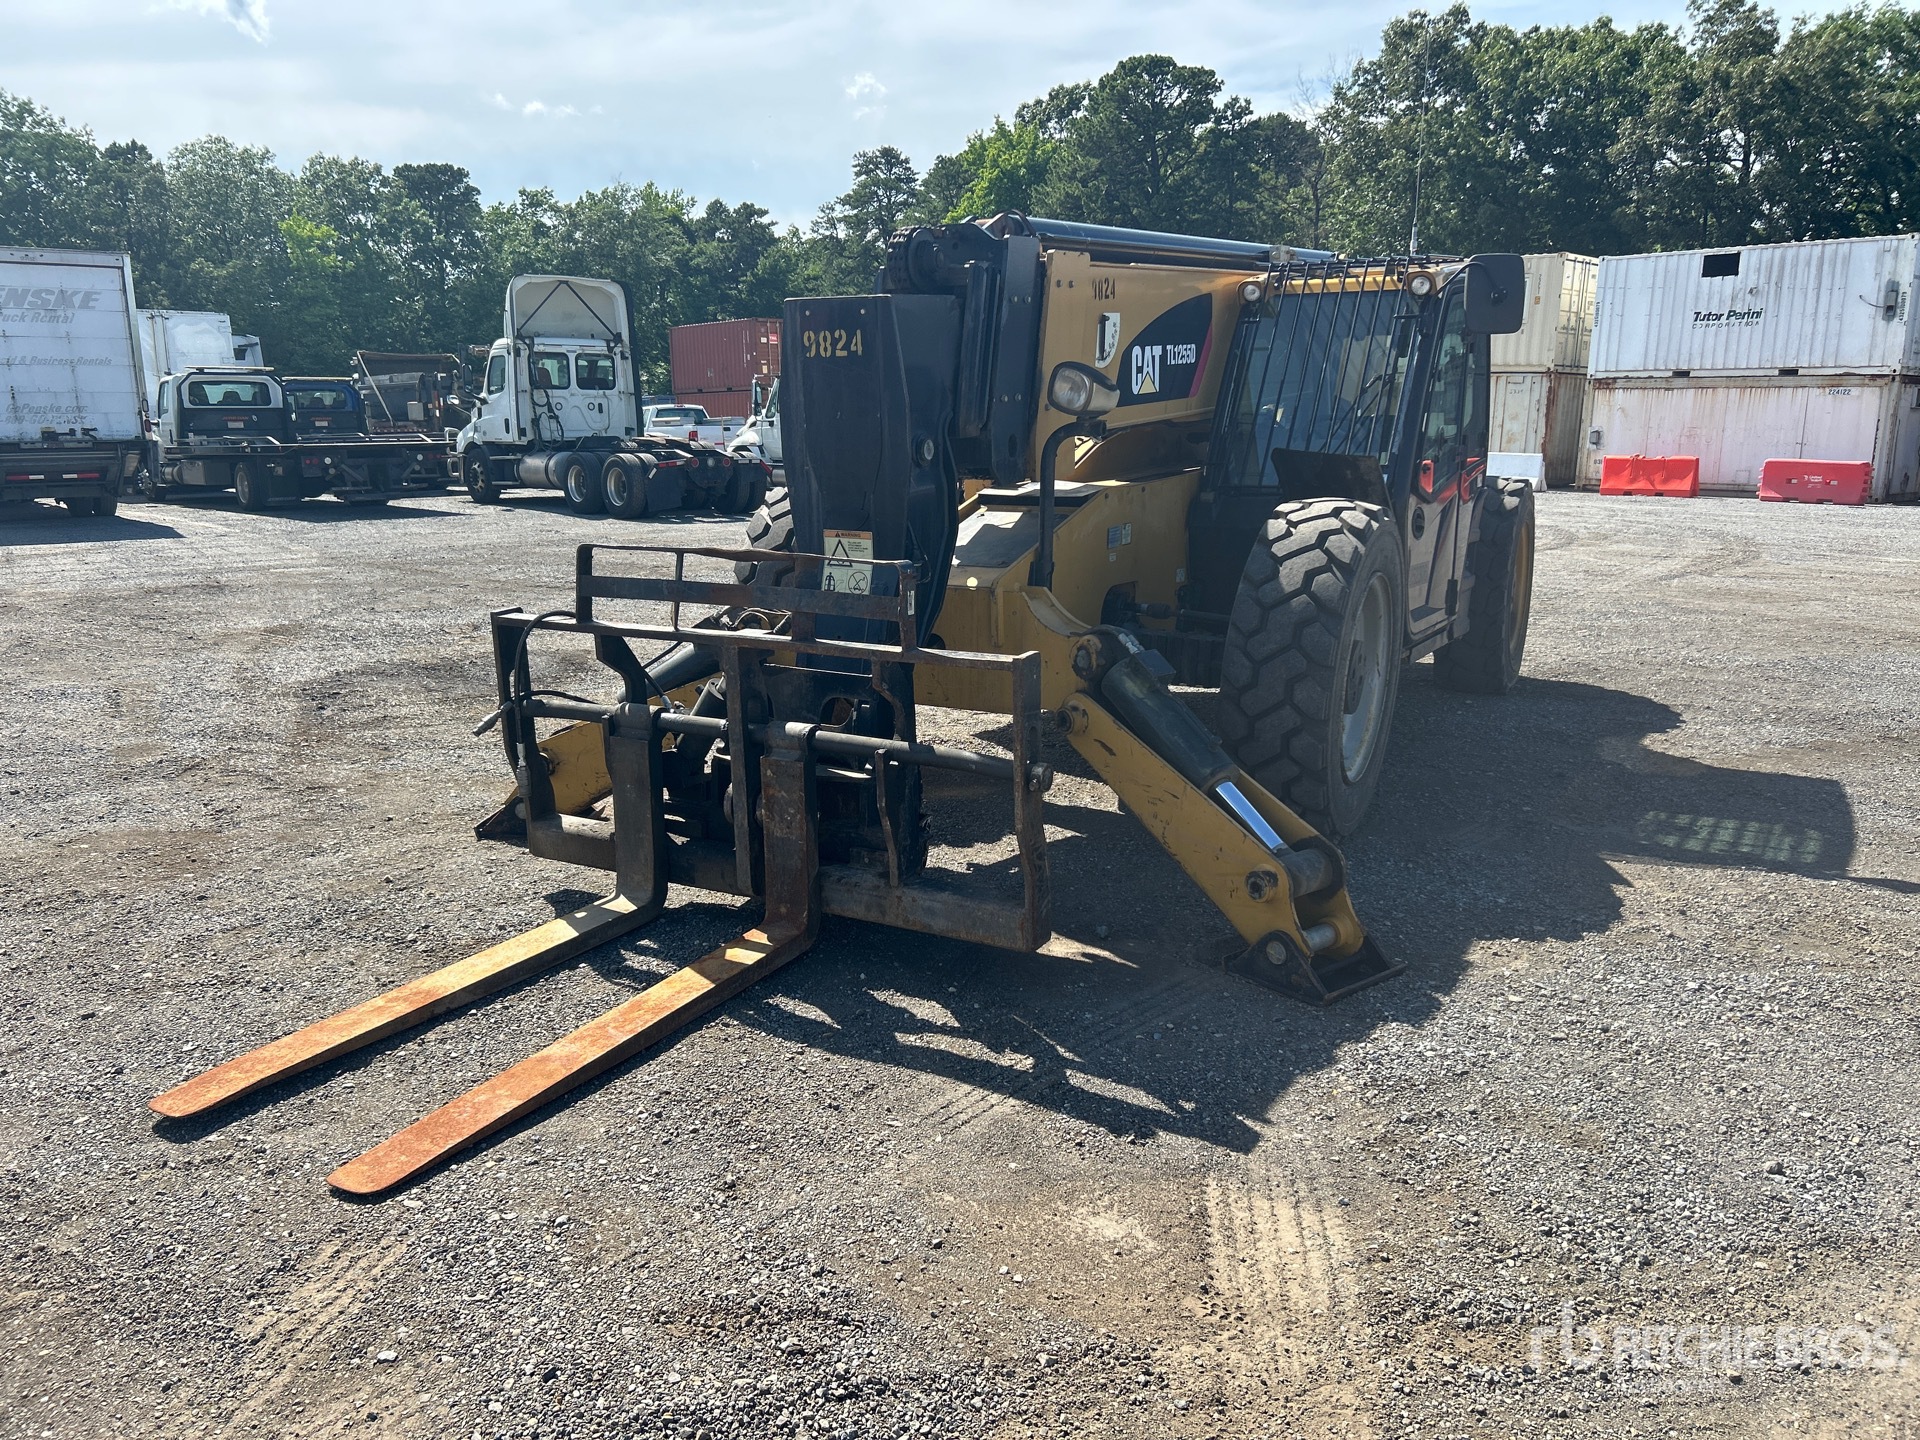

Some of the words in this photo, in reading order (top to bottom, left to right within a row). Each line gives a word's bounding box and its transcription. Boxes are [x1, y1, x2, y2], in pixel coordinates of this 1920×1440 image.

[31, 313, 75, 324] Rental
[1693, 311, 1725, 322] Tutor
[1726, 308, 1764, 321] Perini
[1692, 320, 1760, 330] CORPORATION
[803, 329, 863, 358] 9824
[75, 357, 112, 366] Rentals
[1131, 345, 1163, 395] CAT
[1166, 344, 1196, 365] TL1255D
